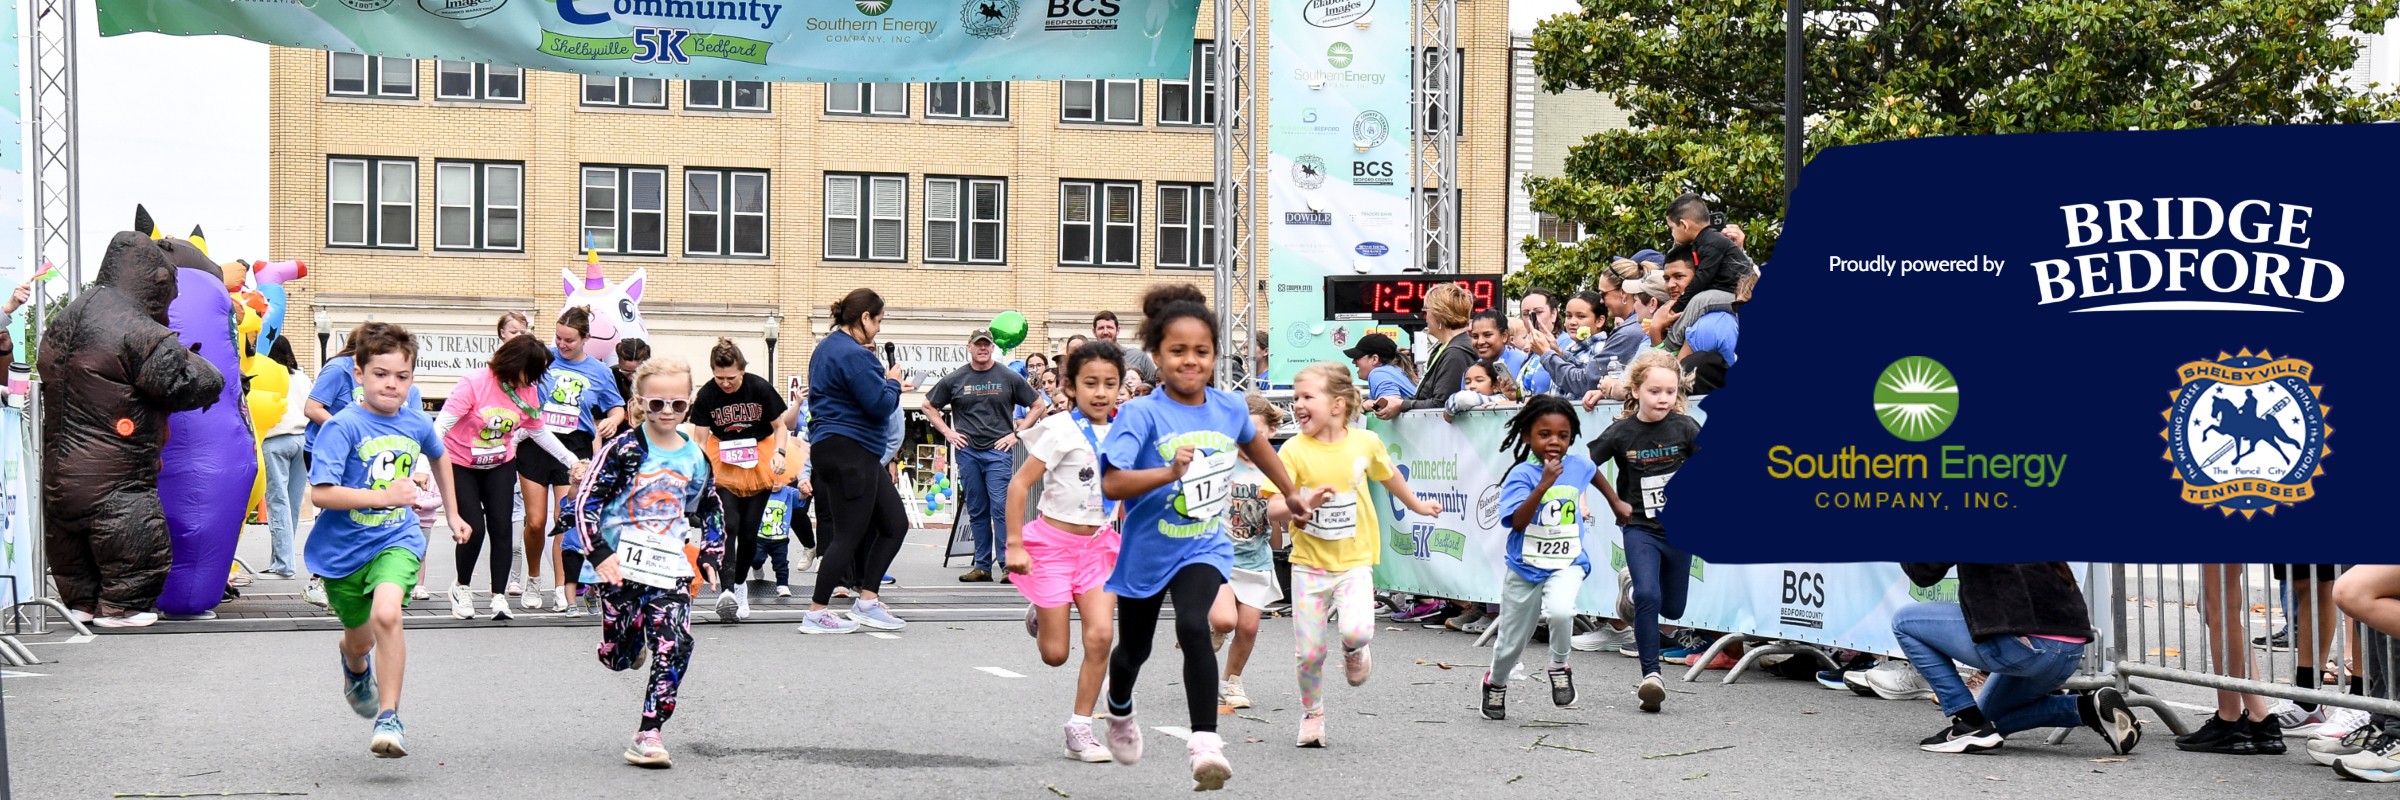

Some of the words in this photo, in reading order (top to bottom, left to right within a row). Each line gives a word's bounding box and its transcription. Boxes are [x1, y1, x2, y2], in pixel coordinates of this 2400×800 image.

[1046, 0, 1120, 17] BCS
[1325, 1, 1361, 16] Images
[806, 17, 874, 31] Southern
[883, 18, 937, 34] Energy
[551, 38, 629, 59] Shelbyville
[632, 27, 690, 63] 5K
[694, 38, 757, 57] Bedford
[1353, 161, 1393, 177] BCS
[1286, 213, 1331, 223] DOWDLE
[438, 335, 500, 352] TREASUR
[466, 358, 488, 368] Mor
[972, 381, 1002, 392] IGNITE
[546, 413, 566, 424] 1010
[726, 450, 744, 461] 852
[1636, 445, 1679, 459] IGNITE
[476, 456, 494, 465] 805
[1195, 480, 1212, 502] 17
[1389, 464, 1468, 521] Cmmunity
[1412, 524, 1435, 558] 5K
[1536, 541, 1570, 555] 1228
[626, 546, 642, 565] 14
[1782, 570, 1825, 608] BCS
[1780, 607, 1806, 618] BEDFORD
[1805, 609, 1824, 620] COUNTY
